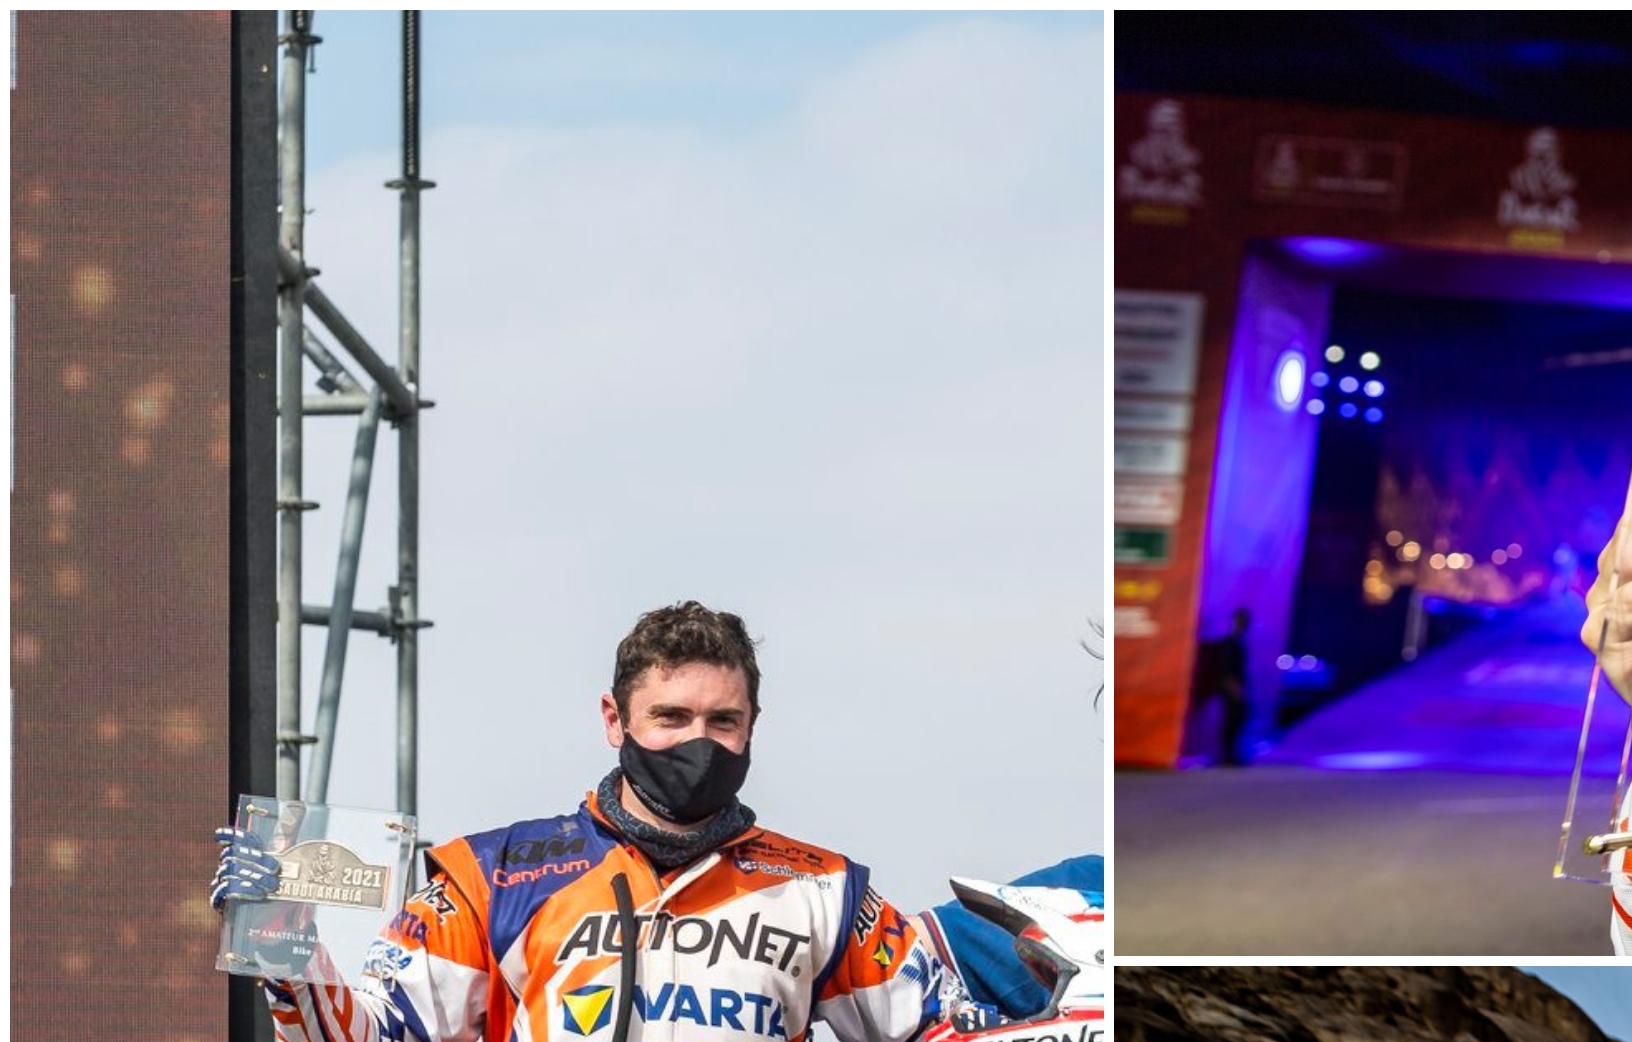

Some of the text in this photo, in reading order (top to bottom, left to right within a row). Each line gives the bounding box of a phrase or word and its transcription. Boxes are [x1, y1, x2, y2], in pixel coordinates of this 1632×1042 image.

[342, 867, 382, 888] 2021
[493, 857, 591, 888] Centrum
[277, 881, 362, 903] SAUDI ARABIA
[633, 982, 789, 1042] VARTA
